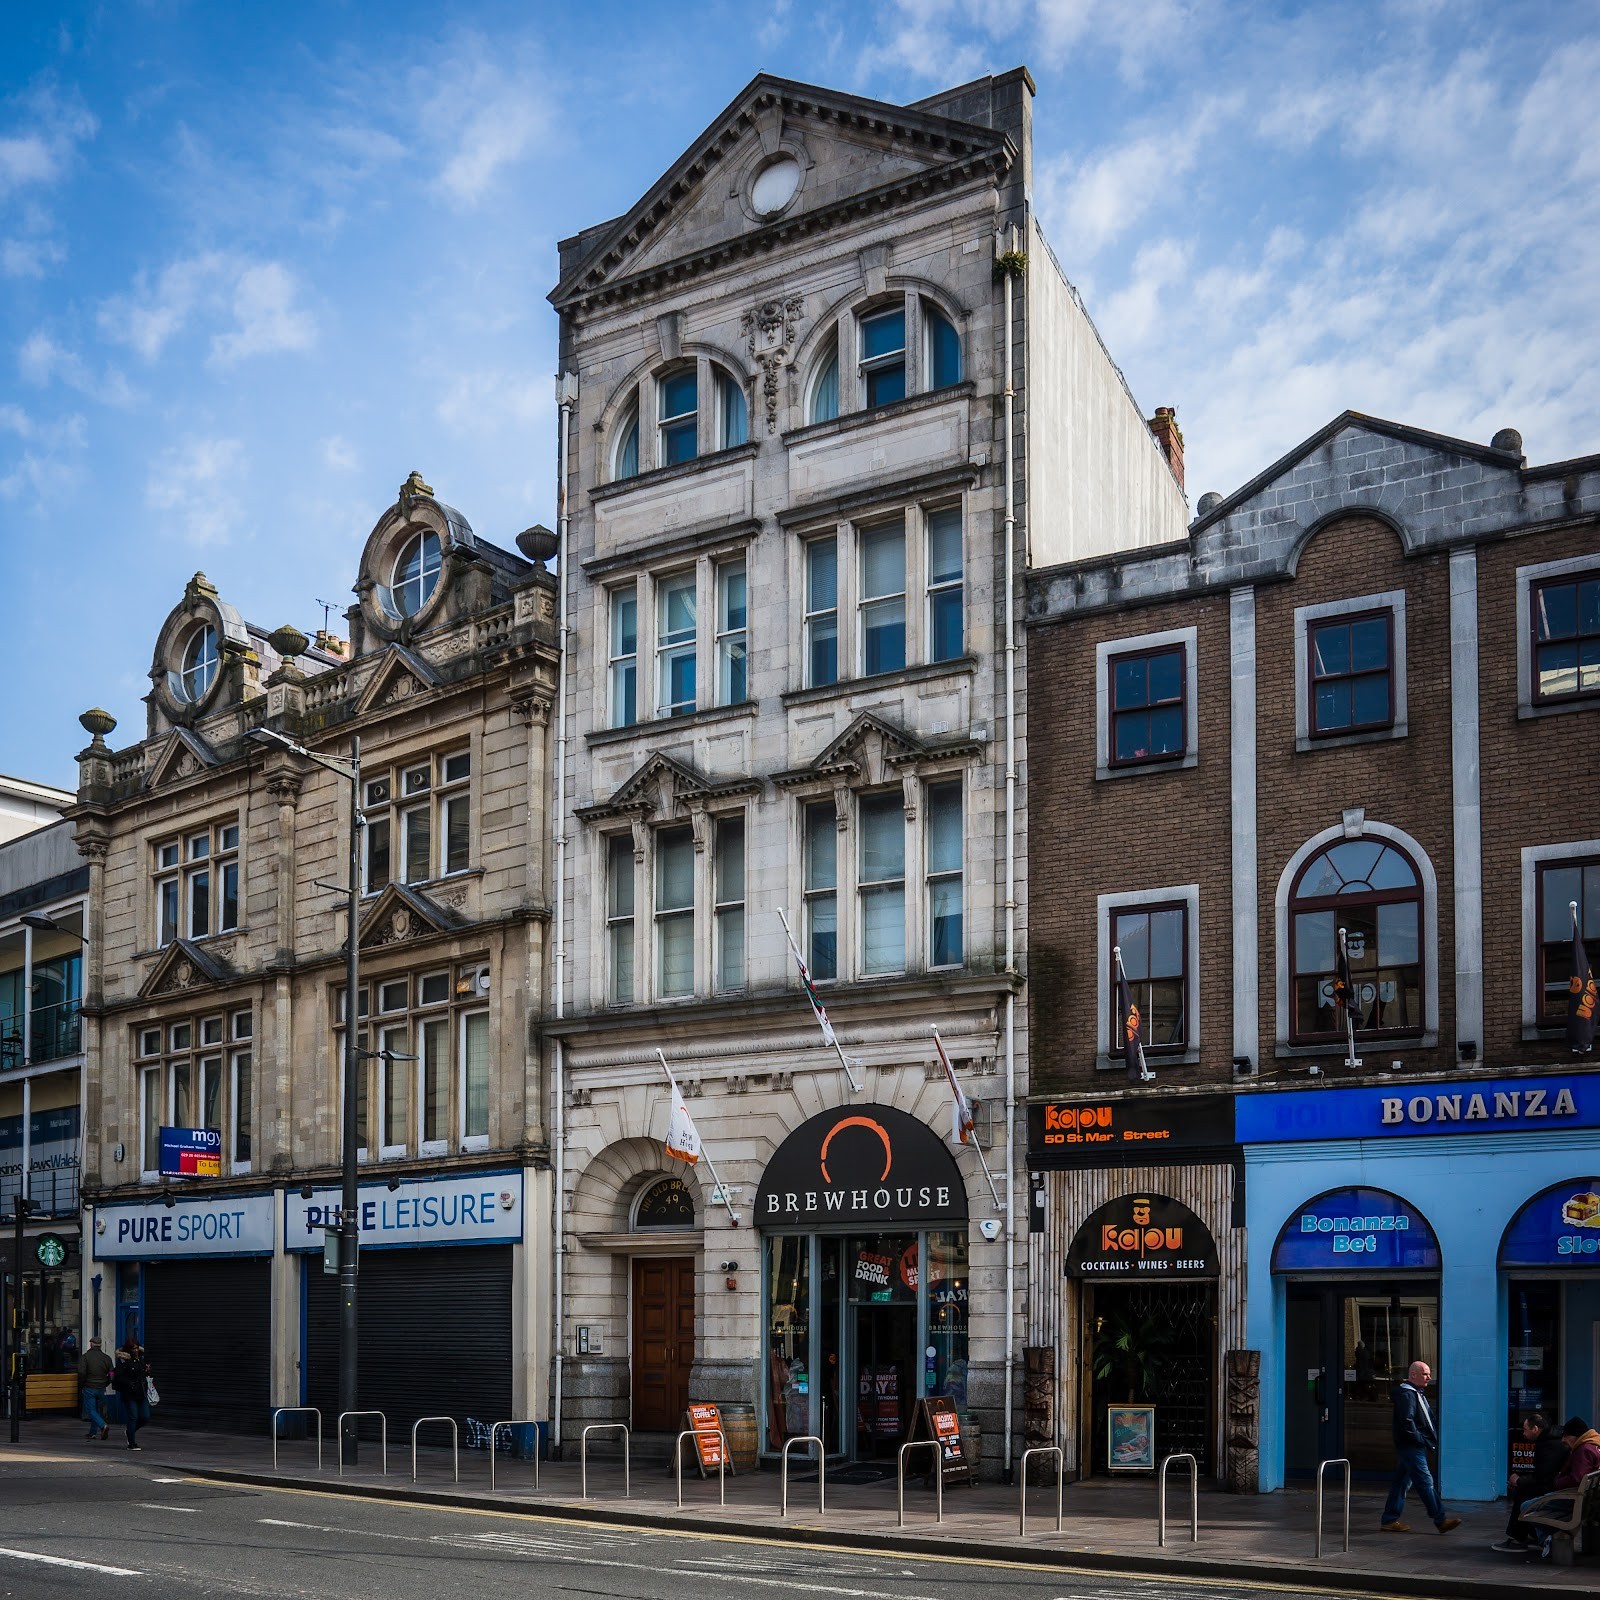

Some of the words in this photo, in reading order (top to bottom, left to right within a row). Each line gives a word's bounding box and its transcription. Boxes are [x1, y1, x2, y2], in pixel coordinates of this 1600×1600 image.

[1382, 1088, 1577, 1124] BONANZA
[192, 1131, 221, 1146] mgy
[1044, 1134, 1064, 1143] 50
[1067, 1133, 1083, 1143] St
[1123, 1130, 1170, 1140] Street
[641, 1195, 653, 1212] THE
[652, 1183, 668, 1197] OLD
[670, 1180, 689, 1194] BRE
[665, 1194, 679, 1205] 49
[766, 1186, 950, 1213] BREWHOUSE
[307, 1201, 376, 1234] PUE
[382, 1192, 495, 1230] LEISURE
[118, 1216, 172, 1243] PURE
[178, 1211, 245, 1241] SPORT
[1301, 1214, 1409, 1232] Bonanza
[1332, 1234, 1377, 1253] Bet
[1557, 1235, 1600, 1254] Slo
[859, 1250, 893, 1266] GREAT
[1080, 1260, 1130, 1271] COCKTAILS
[1138, 1260, 1168, 1269] WINES
[1176, 1259, 1205, 1269] BEERS
[856, 1260, 884, 1274] FOOD
[882, 1266, 890, 1275] &
[855, 1269, 889, 1285] DRINK
